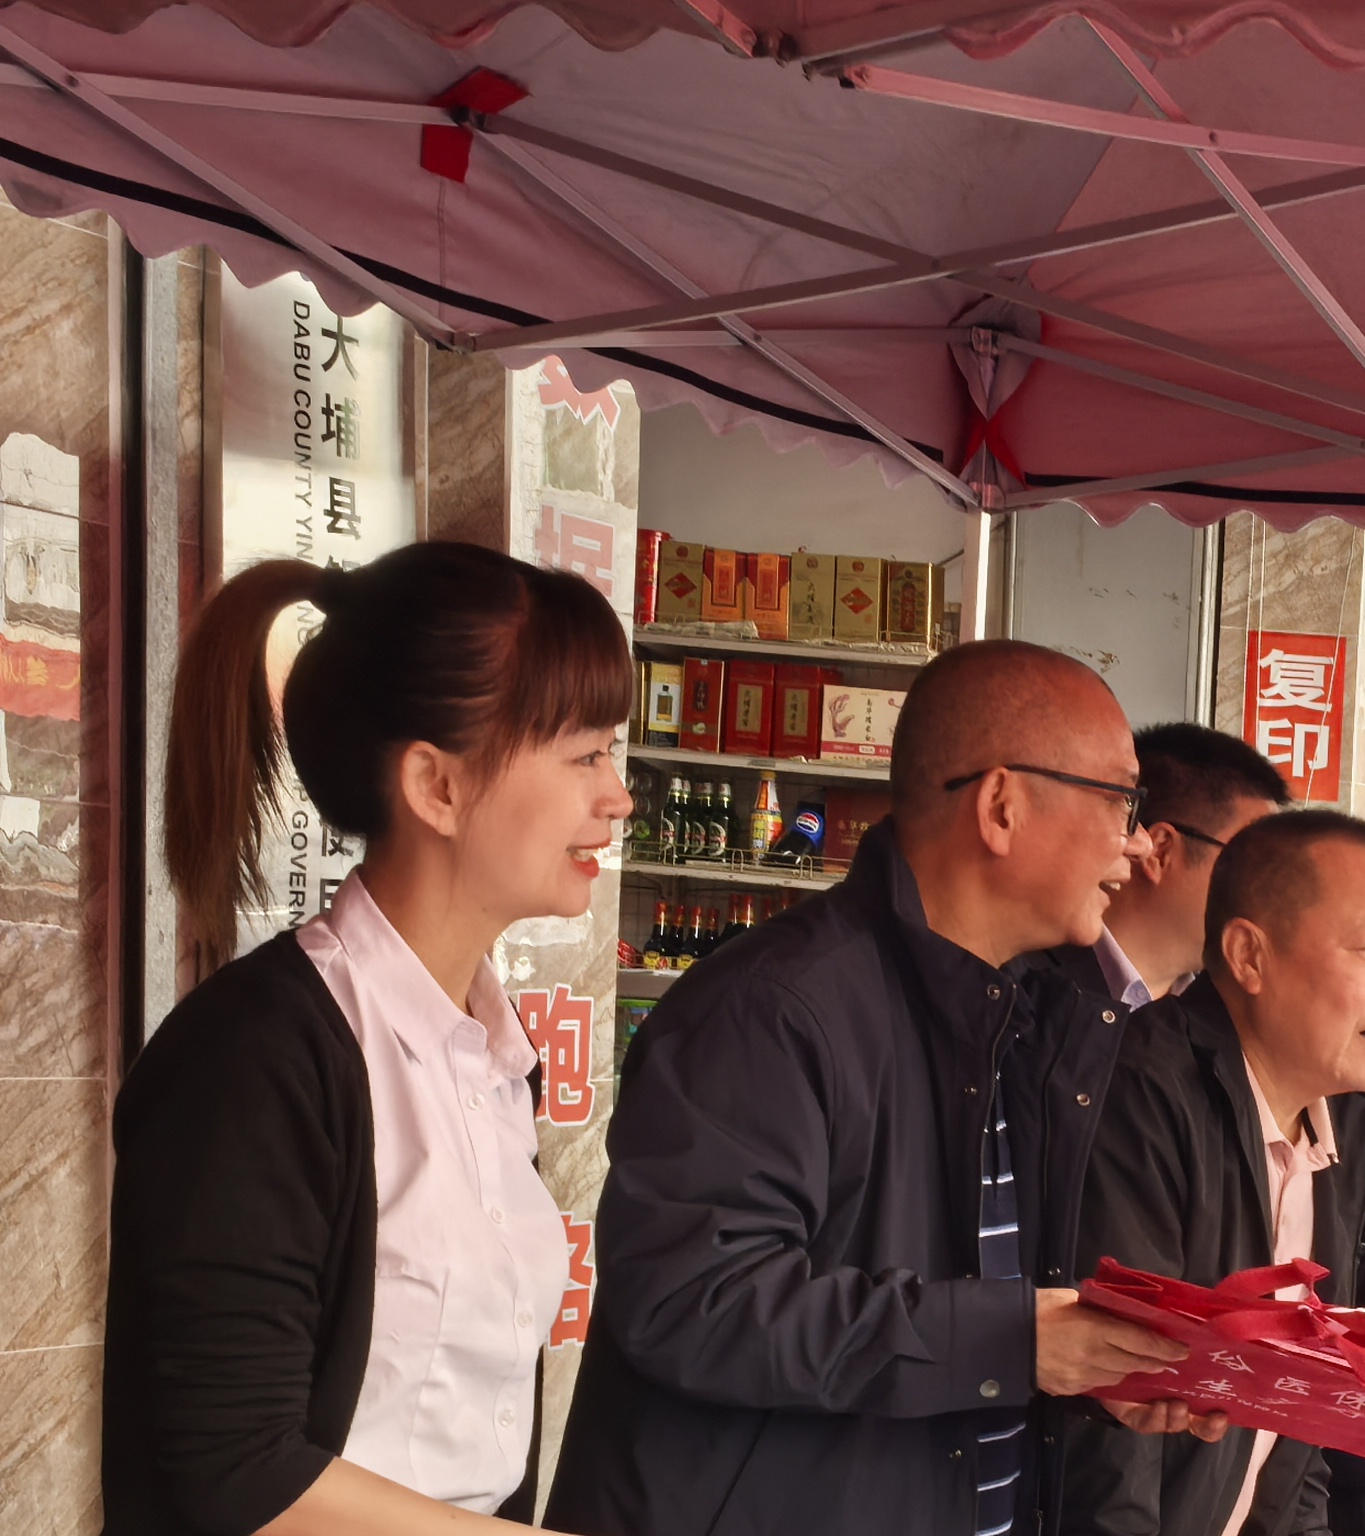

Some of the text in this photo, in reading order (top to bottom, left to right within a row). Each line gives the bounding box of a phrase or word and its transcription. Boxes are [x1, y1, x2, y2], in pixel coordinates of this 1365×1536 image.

[293, 299, 312, 383] DABU
[294, 388, 313, 511] COUNTY
[1257, 649, 1335, 778] 复印
[289, 811, 309, 930] GOVERN
